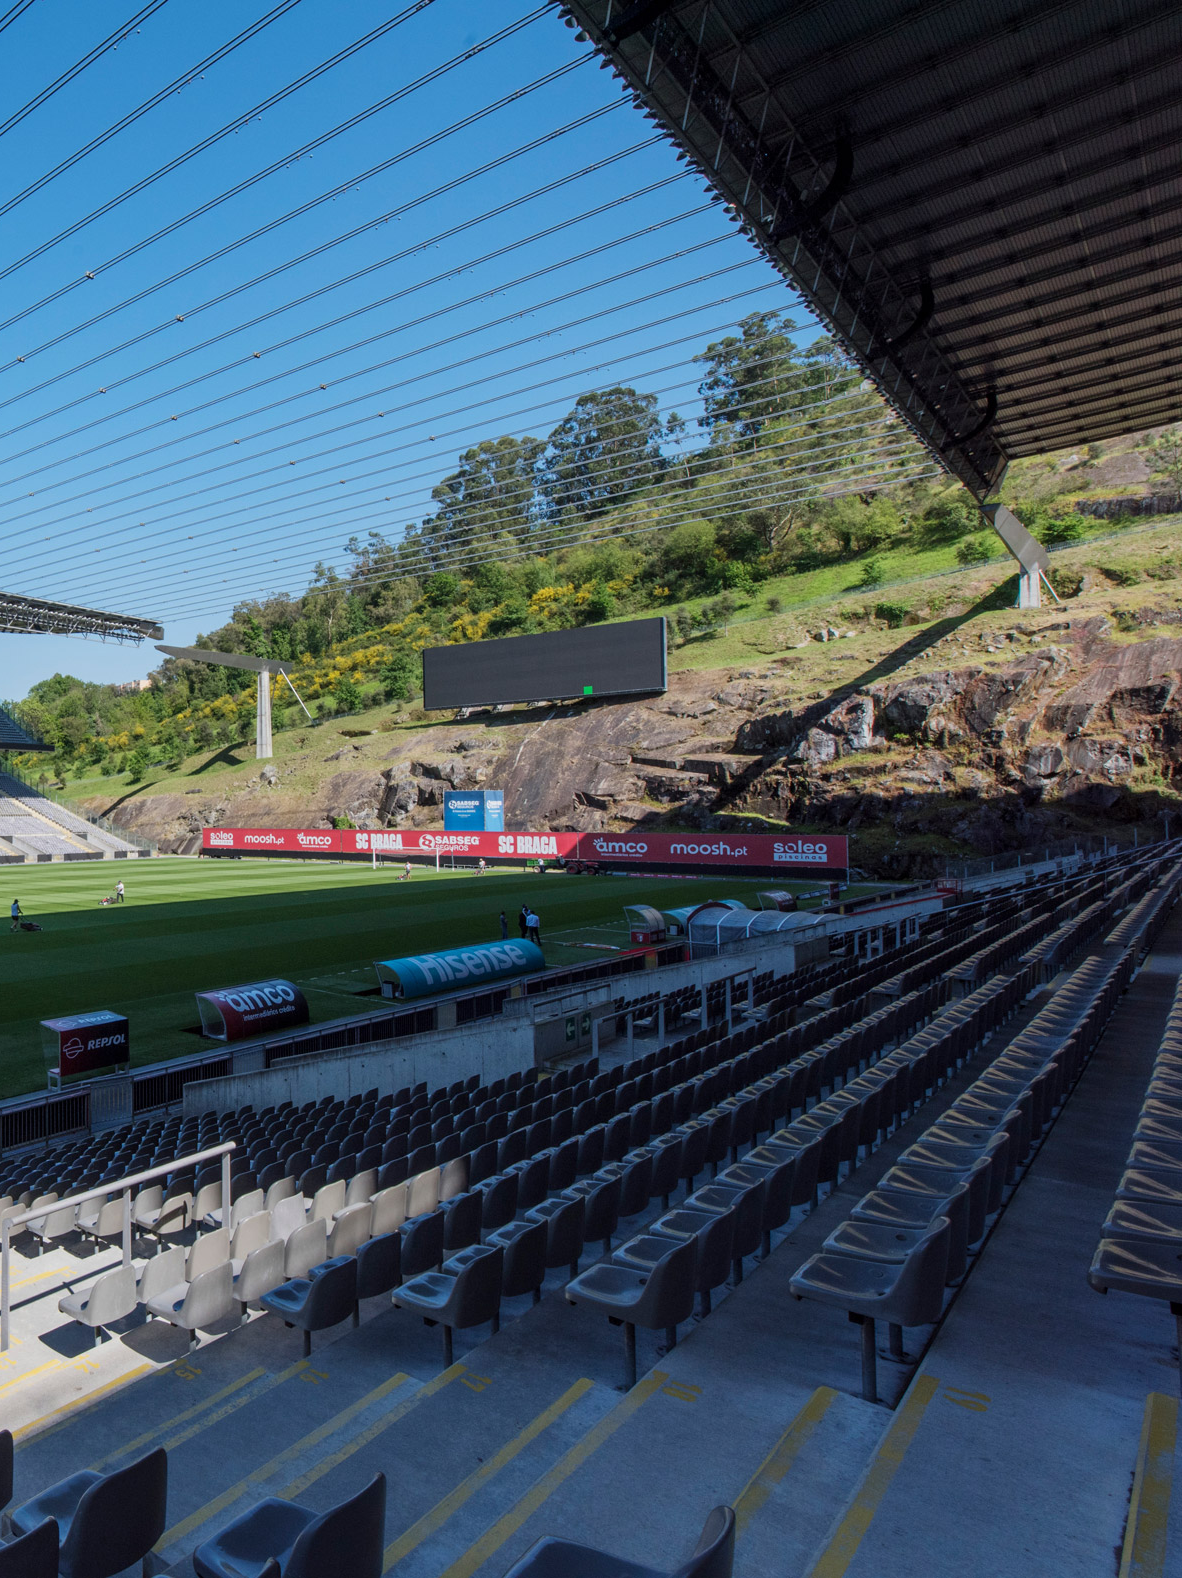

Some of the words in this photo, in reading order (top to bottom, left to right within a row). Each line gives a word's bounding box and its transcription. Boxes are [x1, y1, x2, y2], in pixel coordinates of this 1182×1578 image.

[210, 831, 234, 840] soleo
[244, 834, 285, 846] moosh.pt
[298, 835, 332, 845] amco
[355, 833, 369, 849] SC
[370, 834, 403, 849] BRAGA
[434, 836, 479, 846] SABSEG
[498, 835, 515, 853] SC
[516, 836, 558, 855] BRAGA
[596, 841, 648, 853] amco
[670, 842, 748, 858] moosh.pt
[773, 840, 827, 854] soleo
[406, 944, 527, 986] Hisense
[224, 985, 295, 1012] amco
[87, 1033, 126, 1051] REPSOL
[300, 1368, 329, 1385] 16
[460, 1372, 493, 1392] 17
[662, 1381, 703, 1402] 18
[943, 1386, 991, 1412] 19
